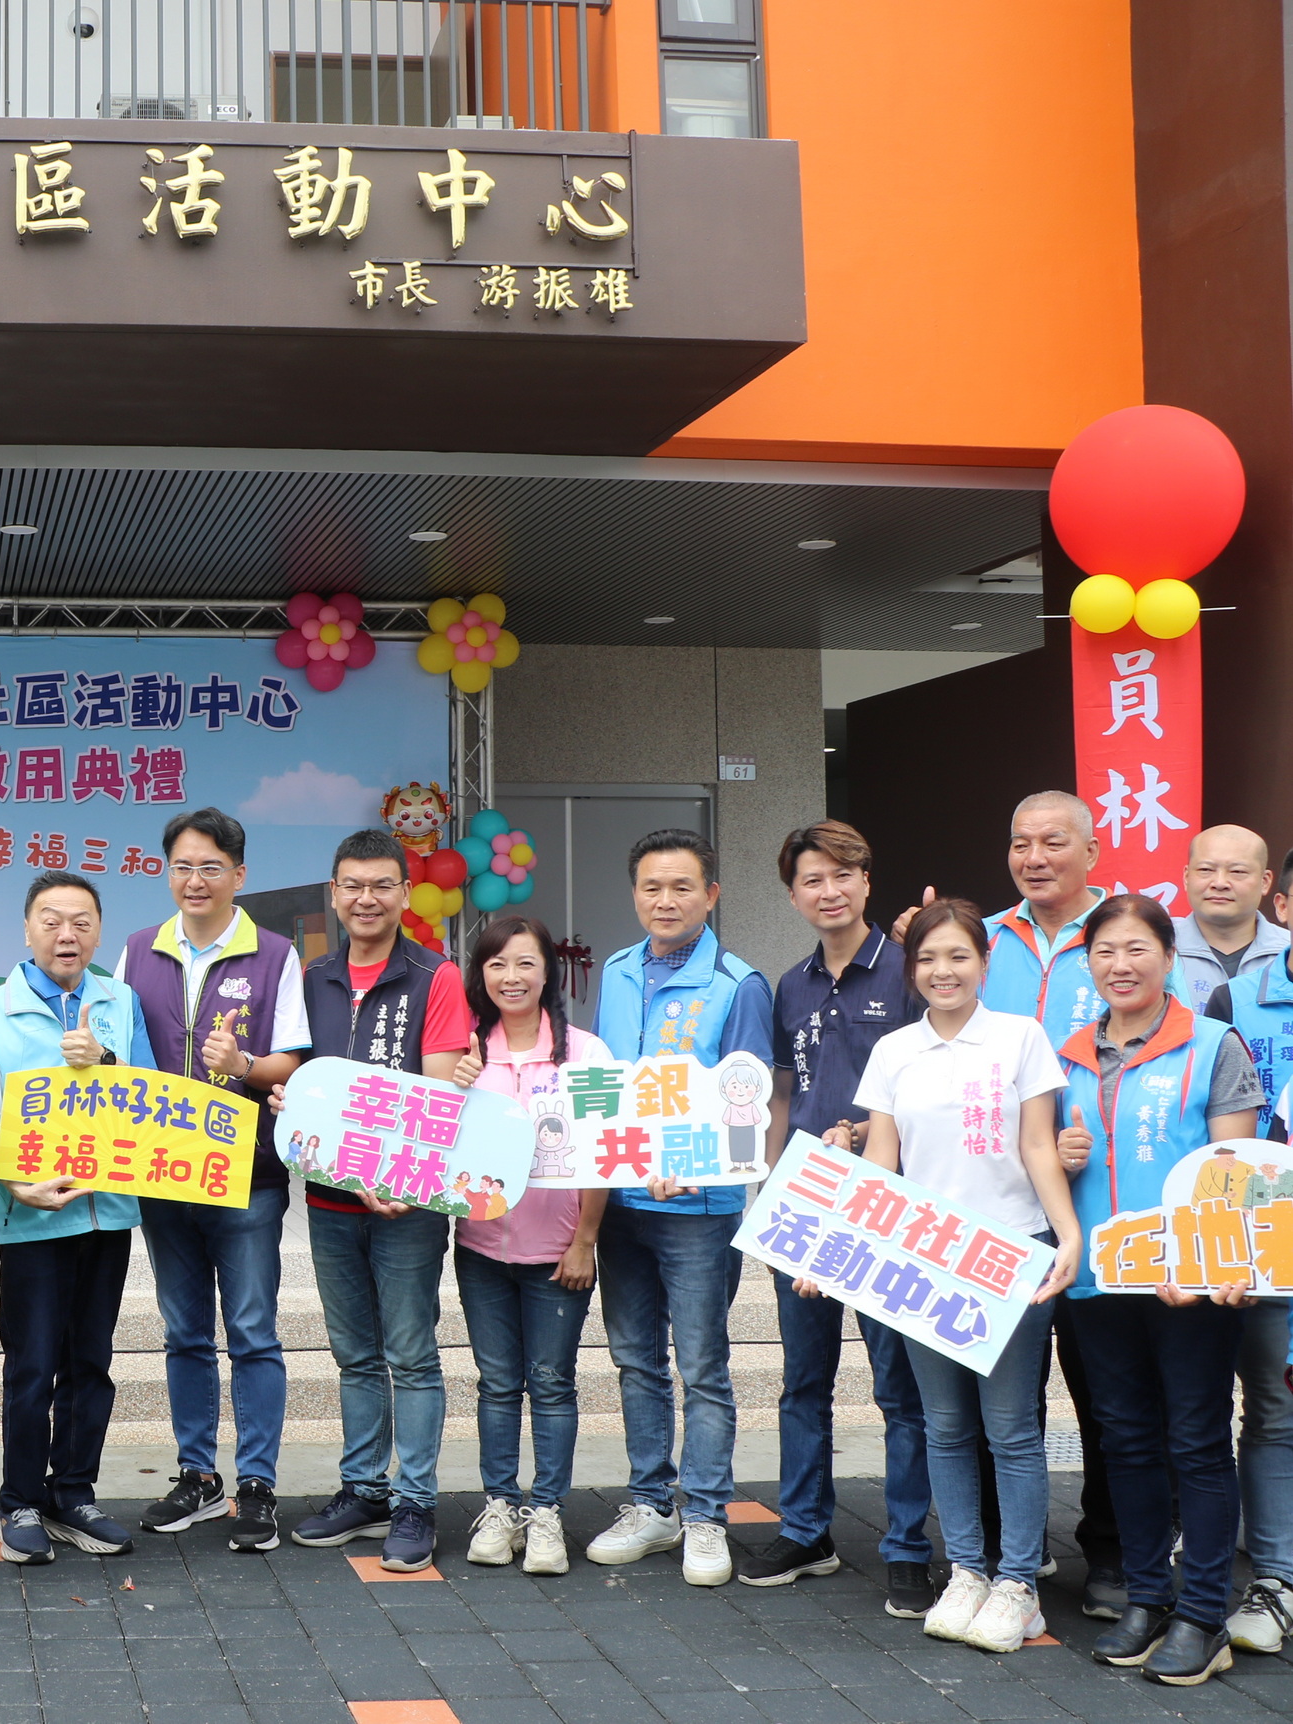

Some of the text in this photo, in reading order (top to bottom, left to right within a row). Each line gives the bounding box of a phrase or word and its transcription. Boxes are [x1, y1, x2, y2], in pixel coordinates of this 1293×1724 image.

[348, 260, 634, 312] 市長 游振雄
[733, 766, 749, 779] 61
[1095, 649, 1189, 914] 員林
[21, 1076, 240, 1146] 員林好社區
[340, 1074, 467, 1148] 幸福
[567, 1063, 692, 1120] 青銀
[962, 1080, 987, 1156] 張詩怡
[16, 1129, 232, 1198] 幸福三和居
[329, 1130, 448, 1204] 員林
[594, 1123, 721, 1180] 共融
[1135, 1104, 1155, 1162] 黃秀雅
[786, 1151, 1032, 1298] 三和社區
[755, 1201, 989, 1347] 活動中心
